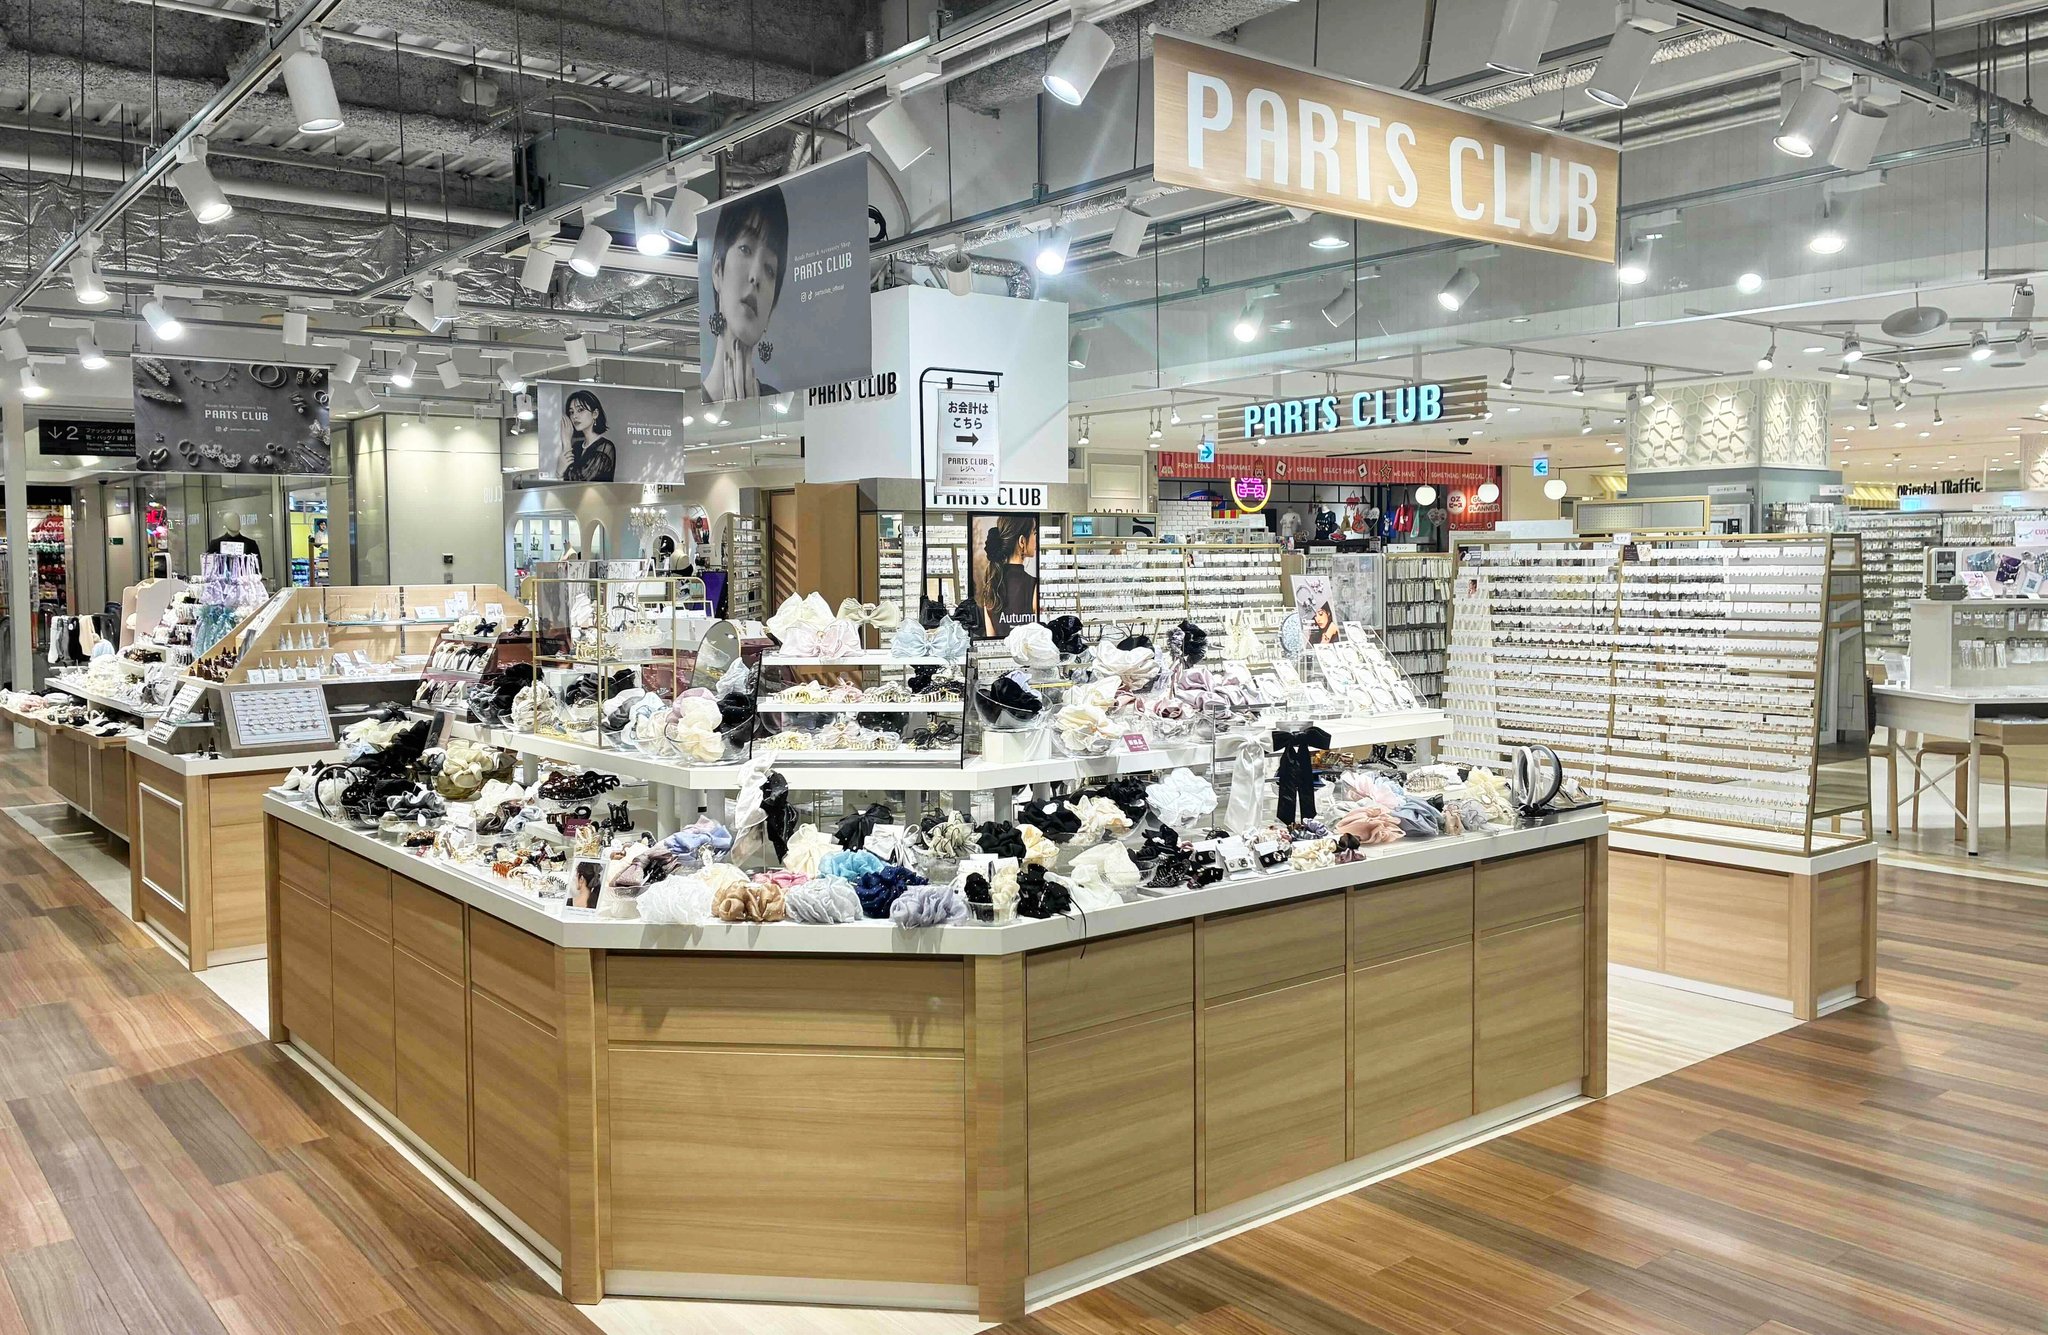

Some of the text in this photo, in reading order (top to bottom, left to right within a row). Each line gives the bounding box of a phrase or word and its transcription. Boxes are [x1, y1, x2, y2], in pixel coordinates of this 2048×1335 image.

[1186, 71, 1598, 242] PARTS CLUB
[794, 252, 852, 282] PARTS CLUB
[858, 372, 897, 398] CLUB
[205, 409, 269, 421] PARTS CLUB
[948, 401, 989, 415] お会計は
[1244, 384, 1444, 439] PARTS CLUB
[953, 417, 983, 430] こちら
[66, 426, 79, 440] 2
[627, 427, 672, 437] PARTS CLUB
[947, 457, 968, 465] PARTS
[997, 487, 1041, 506] CLUB
[1237, 484, 1265, 498] ピース
[1469, 504, 1499, 512] PLANNER
[999, 611, 1037, 624] Autumn
